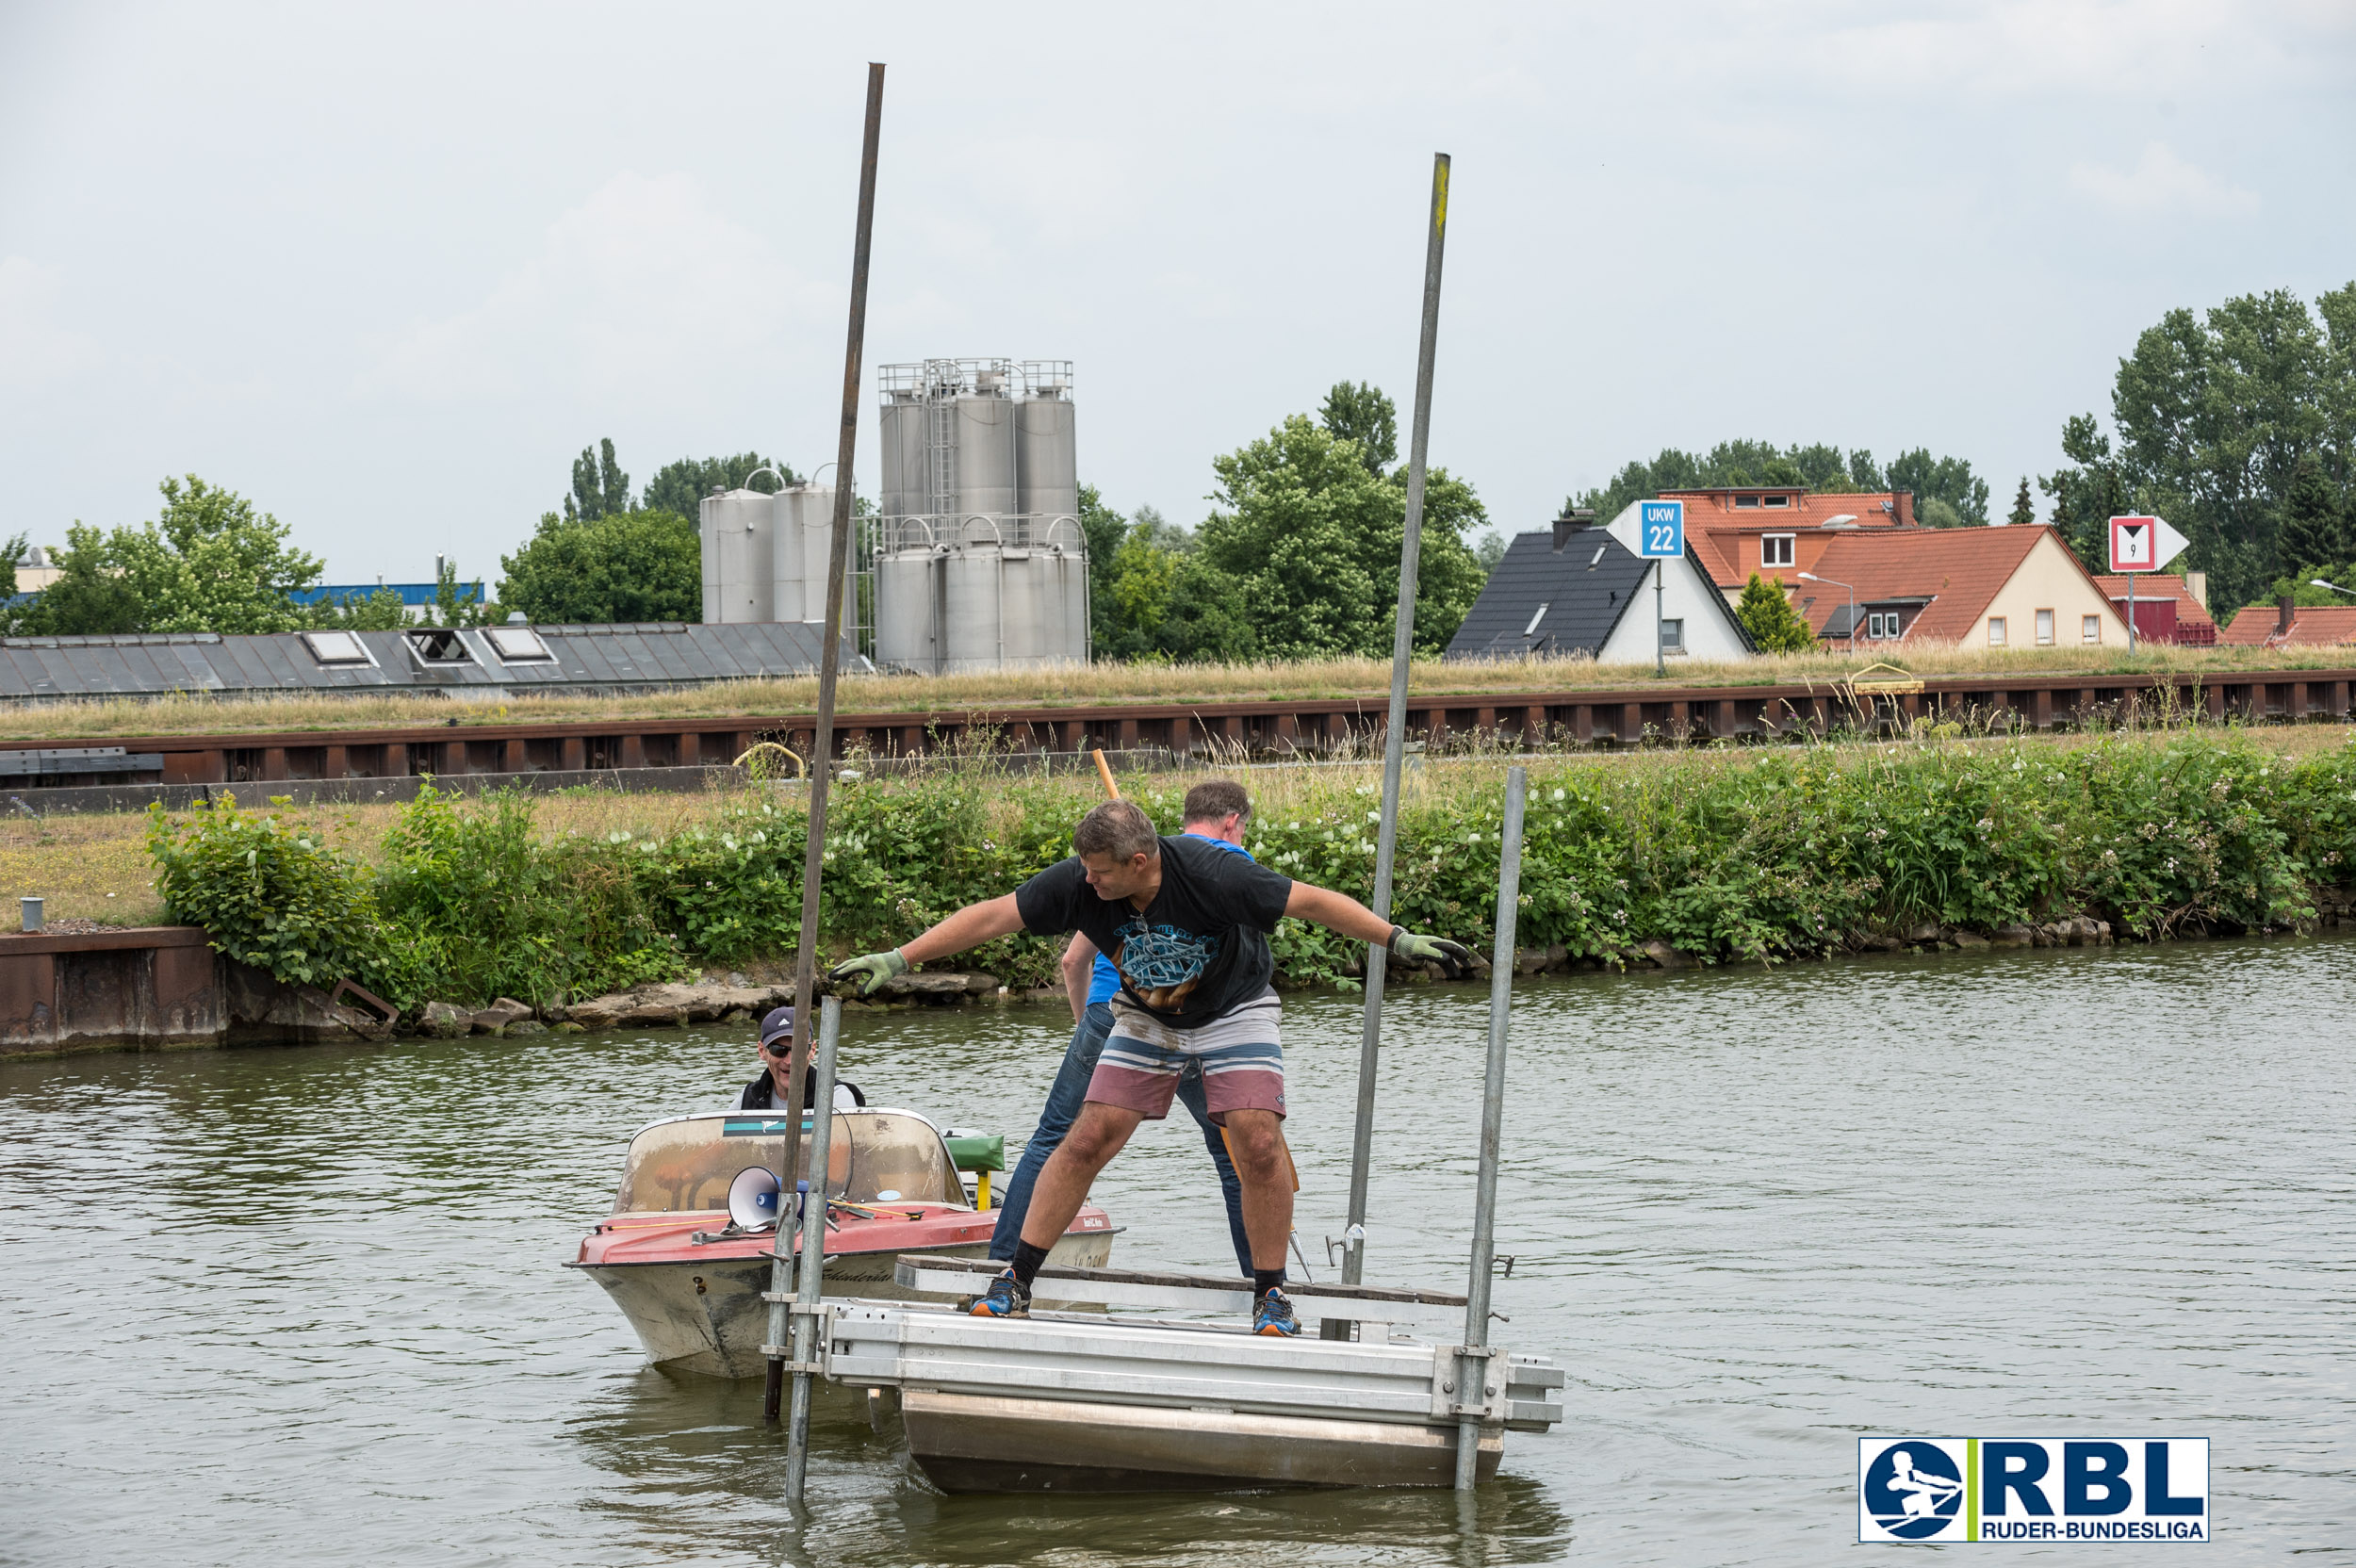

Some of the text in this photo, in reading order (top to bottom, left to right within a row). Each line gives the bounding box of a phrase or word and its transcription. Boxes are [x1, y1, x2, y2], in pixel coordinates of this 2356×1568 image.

[1647, 508, 1675, 522] UKW
[1649, 525, 1675, 551] 22
[2130, 544, 2136, 558] 9
